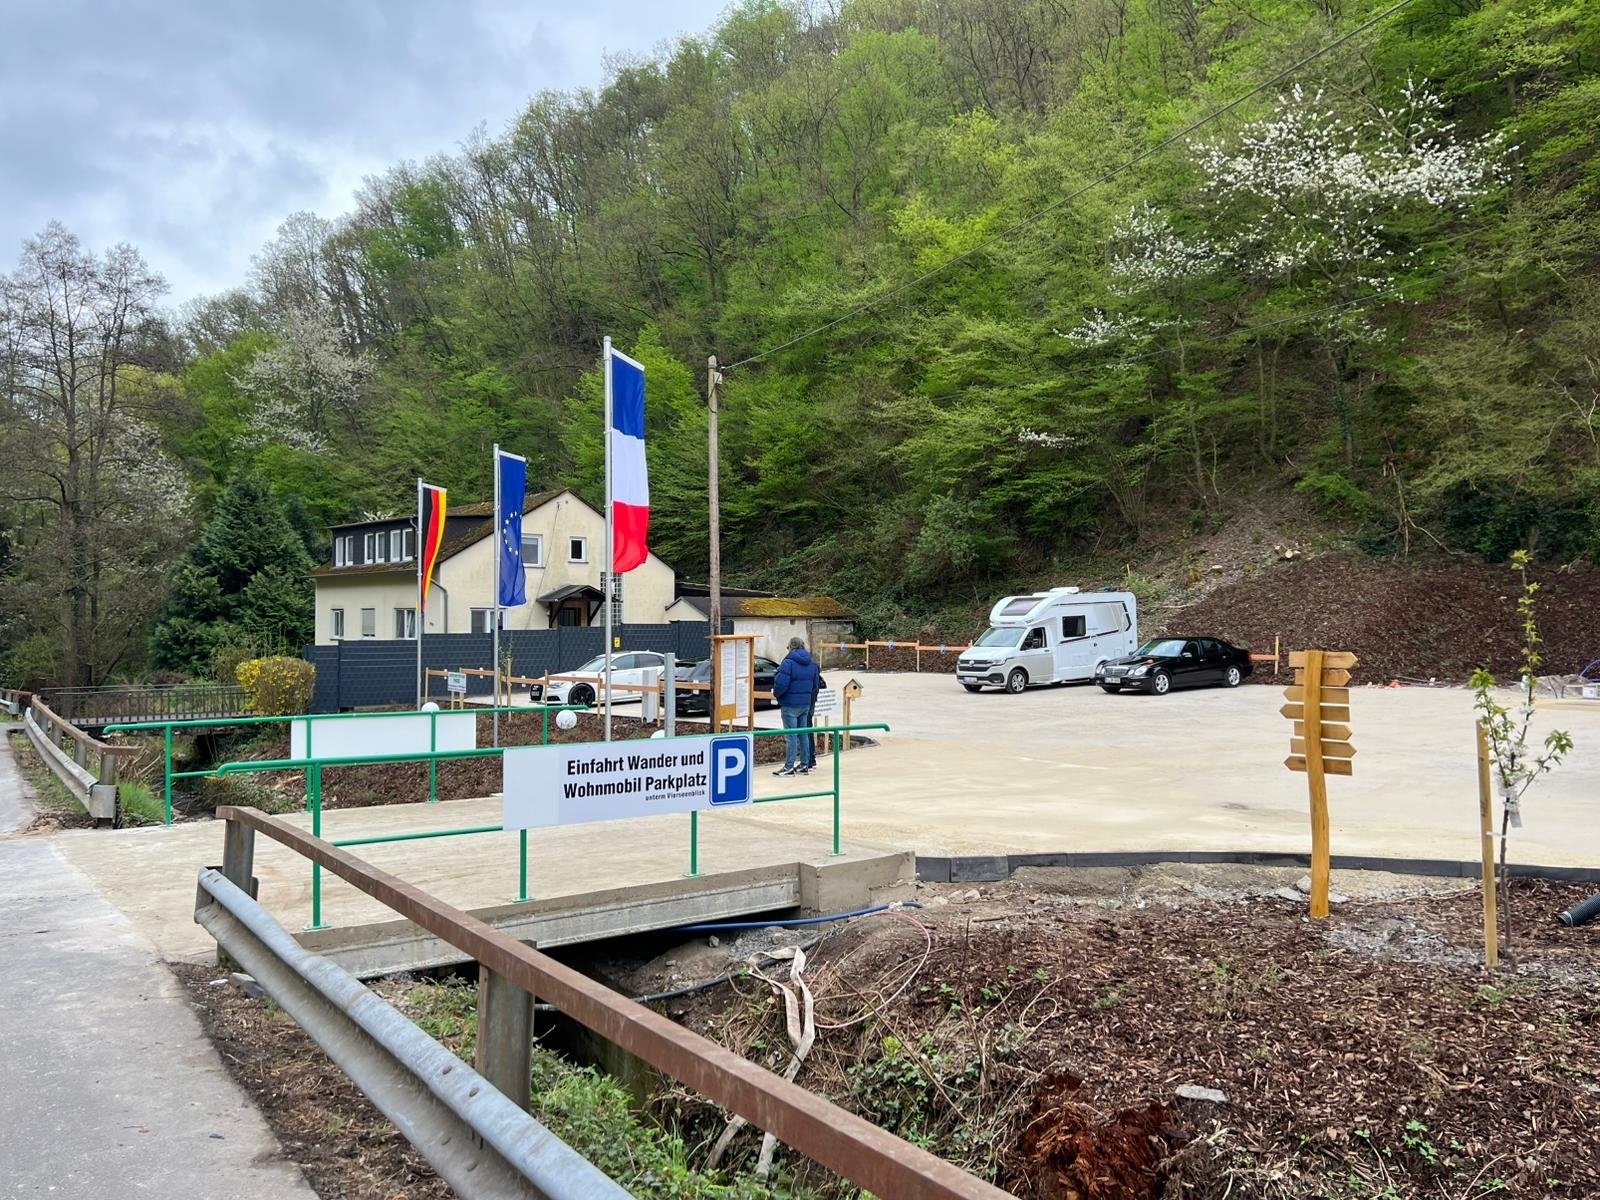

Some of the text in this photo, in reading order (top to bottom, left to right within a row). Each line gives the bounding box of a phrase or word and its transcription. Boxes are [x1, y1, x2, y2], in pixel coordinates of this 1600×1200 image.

[567, 750, 704, 775] Einfahrt Wander und
[717, 747, 746, 795] P
[563, 773, 707, 799] Wohnmobil Parkplatz
[645, 793, 666, 801] unterm
